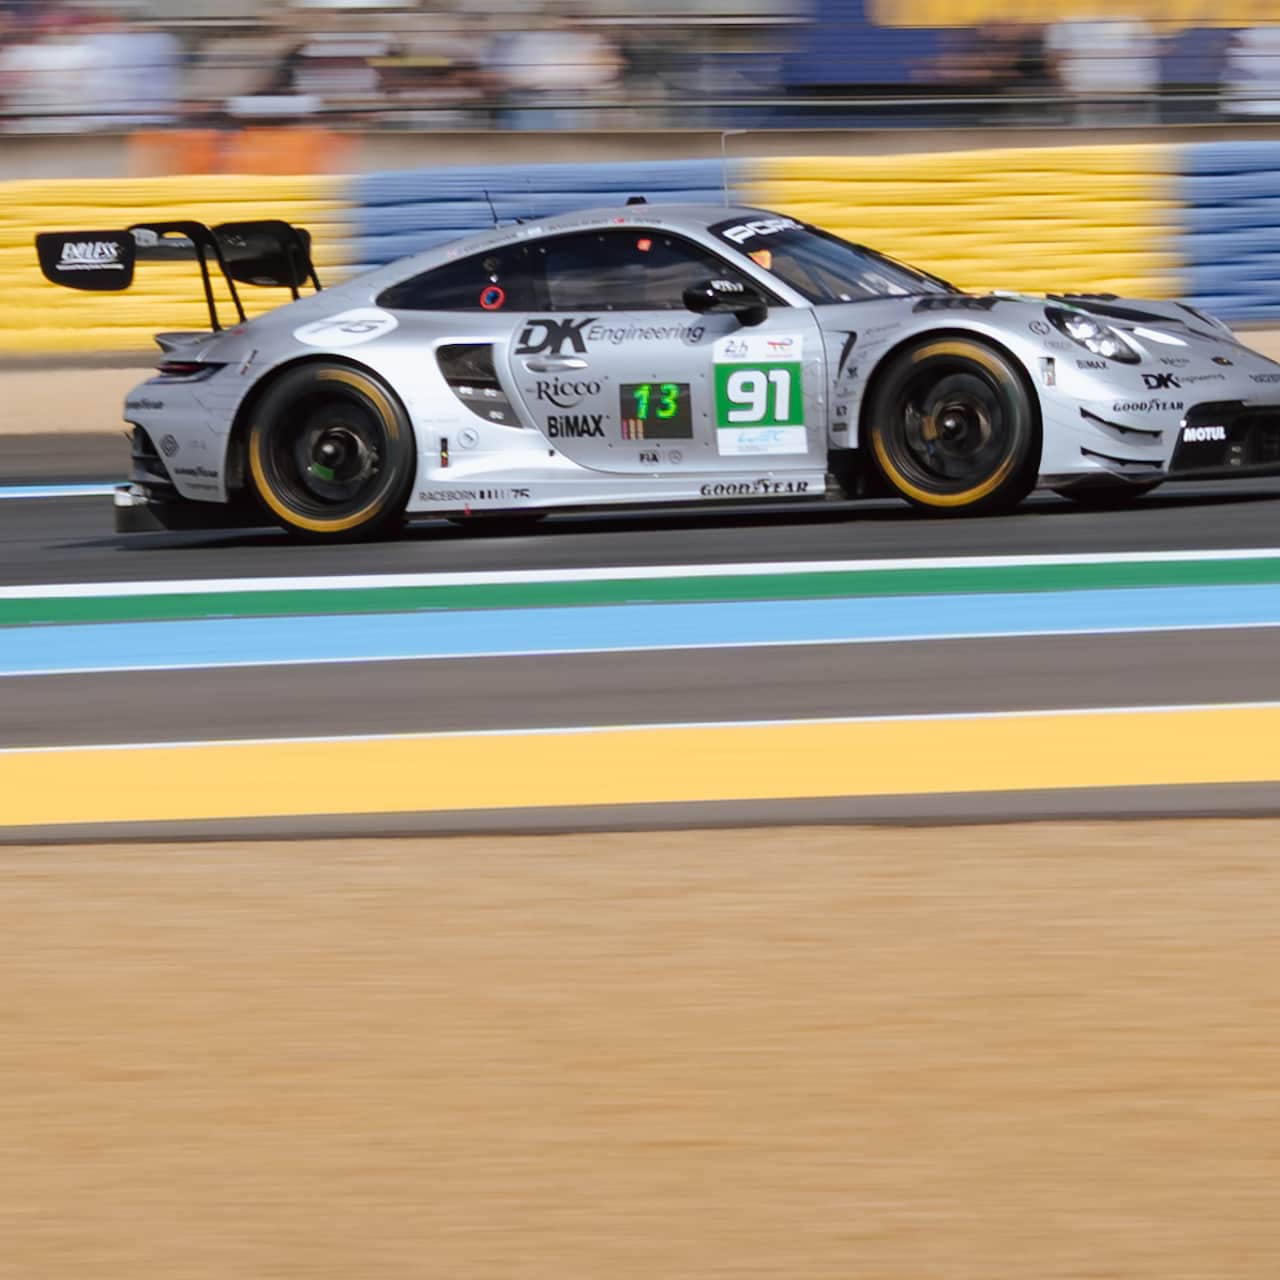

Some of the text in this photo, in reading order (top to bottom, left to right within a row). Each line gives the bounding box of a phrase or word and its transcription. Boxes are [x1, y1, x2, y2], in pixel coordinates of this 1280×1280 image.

[514, 317, 705, 356] DK Engineering
[536, 377, 601, 408] Ricco
[1141, 372, 1182, 390] DK
[633, 382, 680, 420] 13
[727, 369, 791, 423] 91
[1113, 399, 1184, 414] GOODYEAR
[547, 414, 606, 438] BiMAX
[1183, 426, 1226, 442] MOTUL
[700, 478, 809, 497] GOODYEAR
